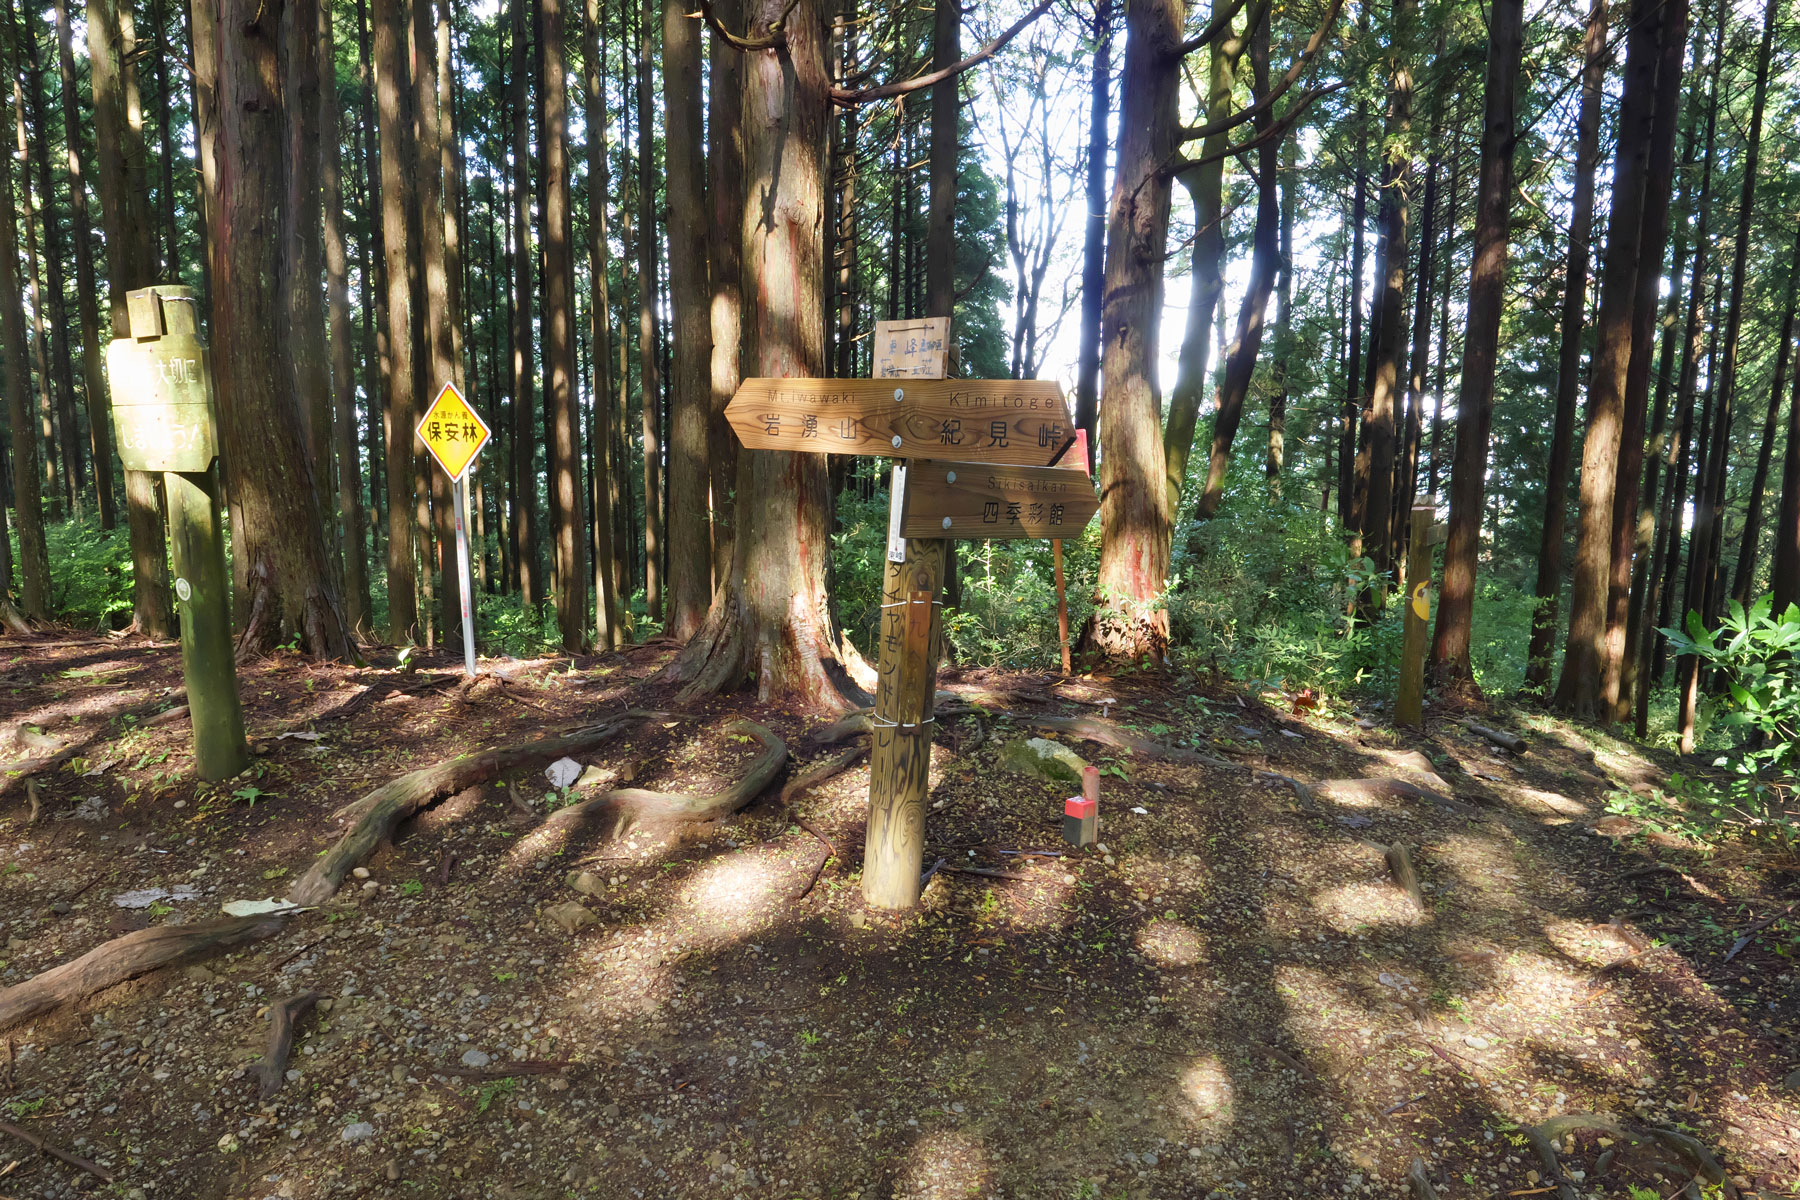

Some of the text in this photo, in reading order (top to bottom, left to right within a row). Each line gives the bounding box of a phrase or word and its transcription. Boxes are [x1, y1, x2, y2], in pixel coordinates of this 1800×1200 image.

[427, 421, 478, 442] 保安林
[764, 413, 857, 440] 岩湧山
[940, 419, 1061, 451] 紀見峠
[983, 501, 1065, 526] 四季彩館
